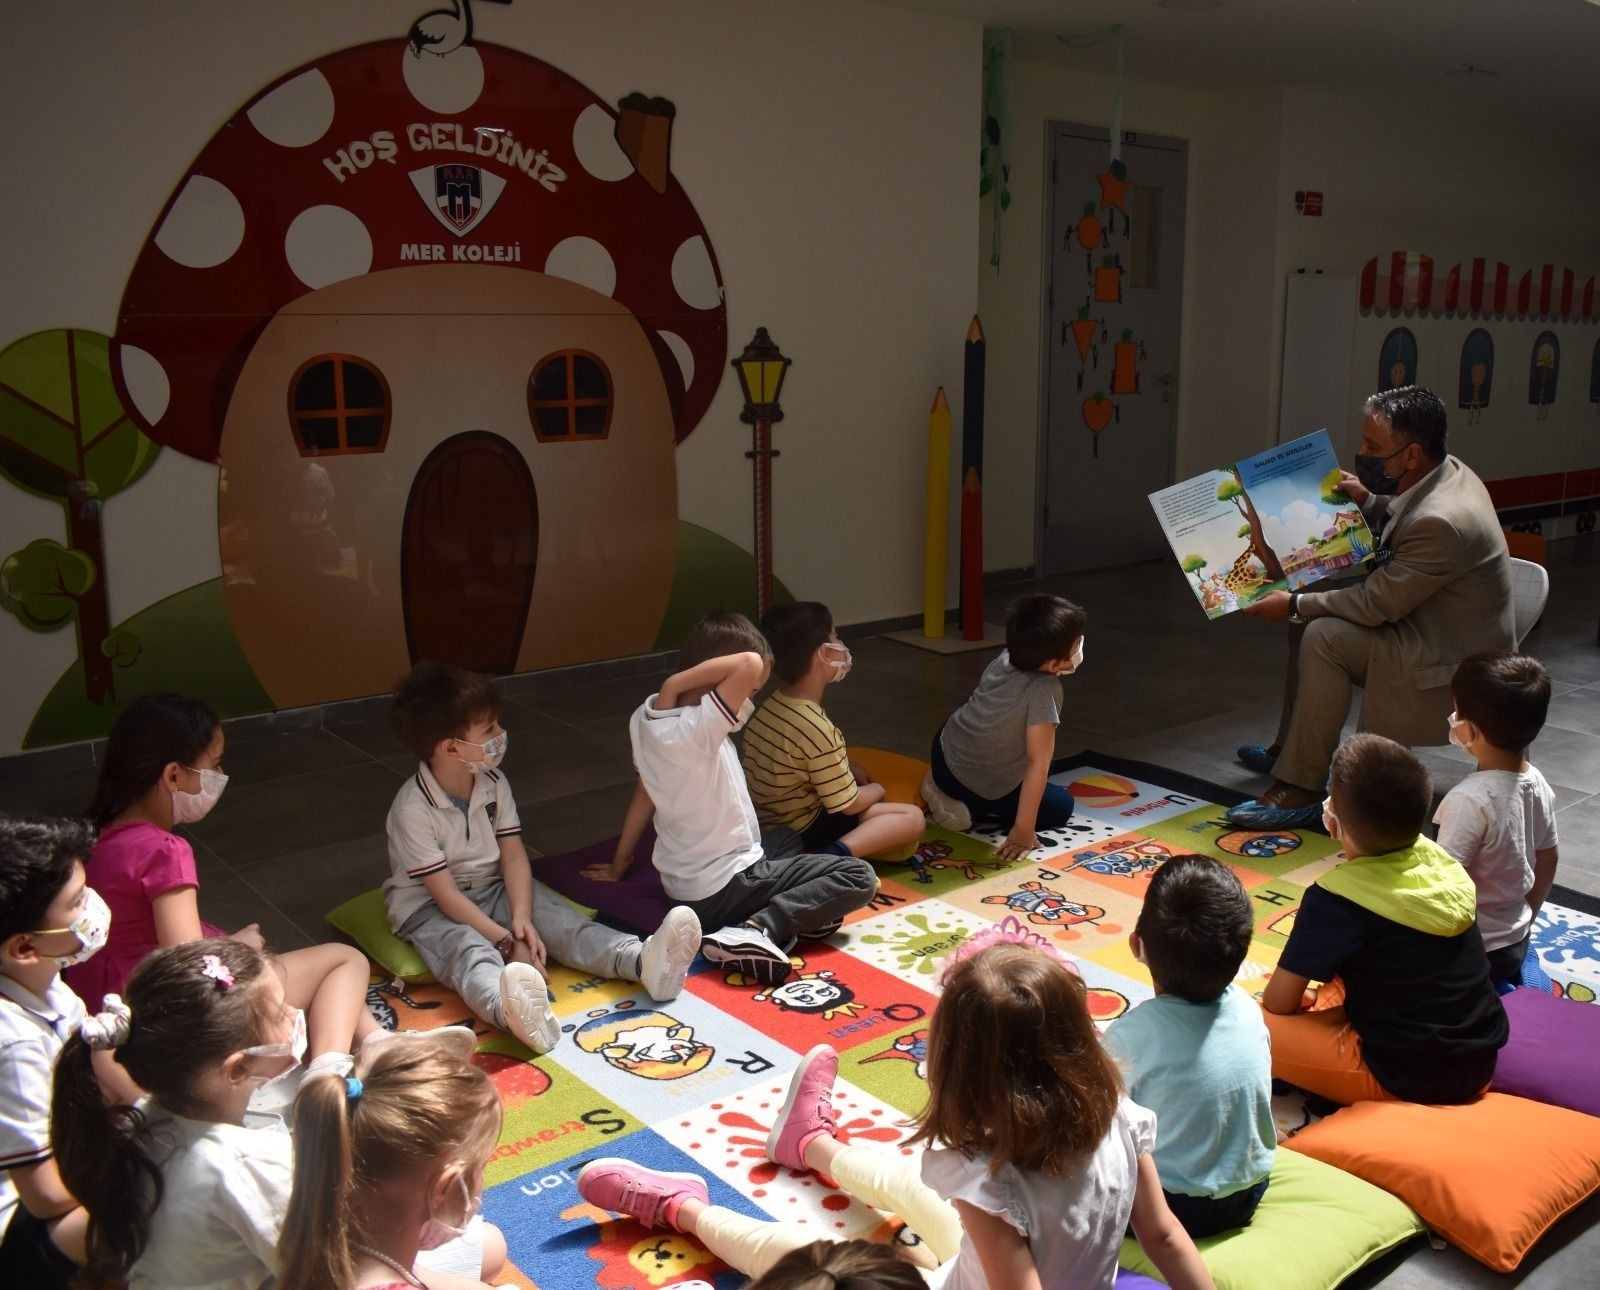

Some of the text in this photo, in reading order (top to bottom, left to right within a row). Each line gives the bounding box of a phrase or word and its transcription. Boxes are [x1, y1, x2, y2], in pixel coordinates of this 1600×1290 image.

[323, 122, 568, 192] HOŞ GELDİNİZ
[400, 241, 521, 262] MER KOLEJİ
[1119, 794, 1197, 817] Umbrella
[1556, 929, 1589, 947] blue
[828, 1003, 926, 1039] Queen
